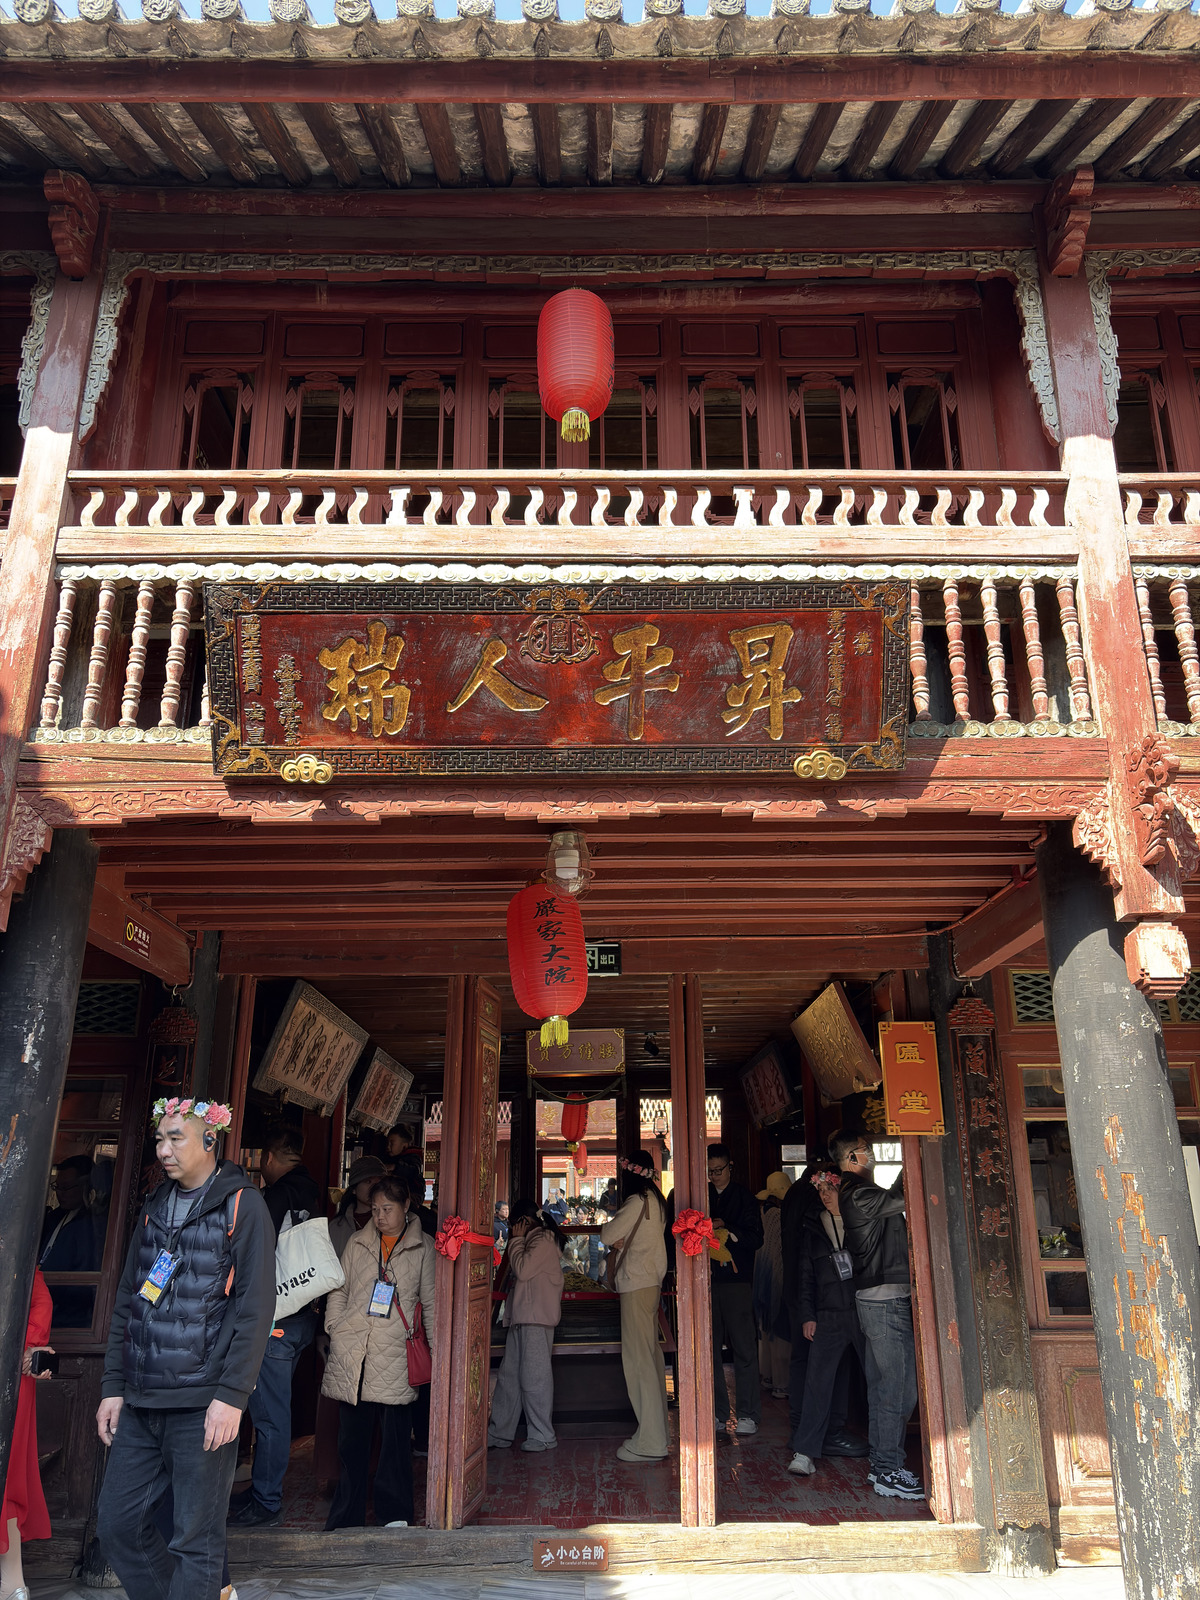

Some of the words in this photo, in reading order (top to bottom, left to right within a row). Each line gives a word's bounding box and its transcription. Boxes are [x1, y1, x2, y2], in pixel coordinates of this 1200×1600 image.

[533, 896, 576, 987] 嚴家大院
[600, 954, 615, 965] 出口
[895, 1042, 931, 1115] 匾堂
[153, 1270, 165, 1284] 05
[377, 1293, 387, 1302] 05
[557, 1546, 605, 1559] 小心台阶
